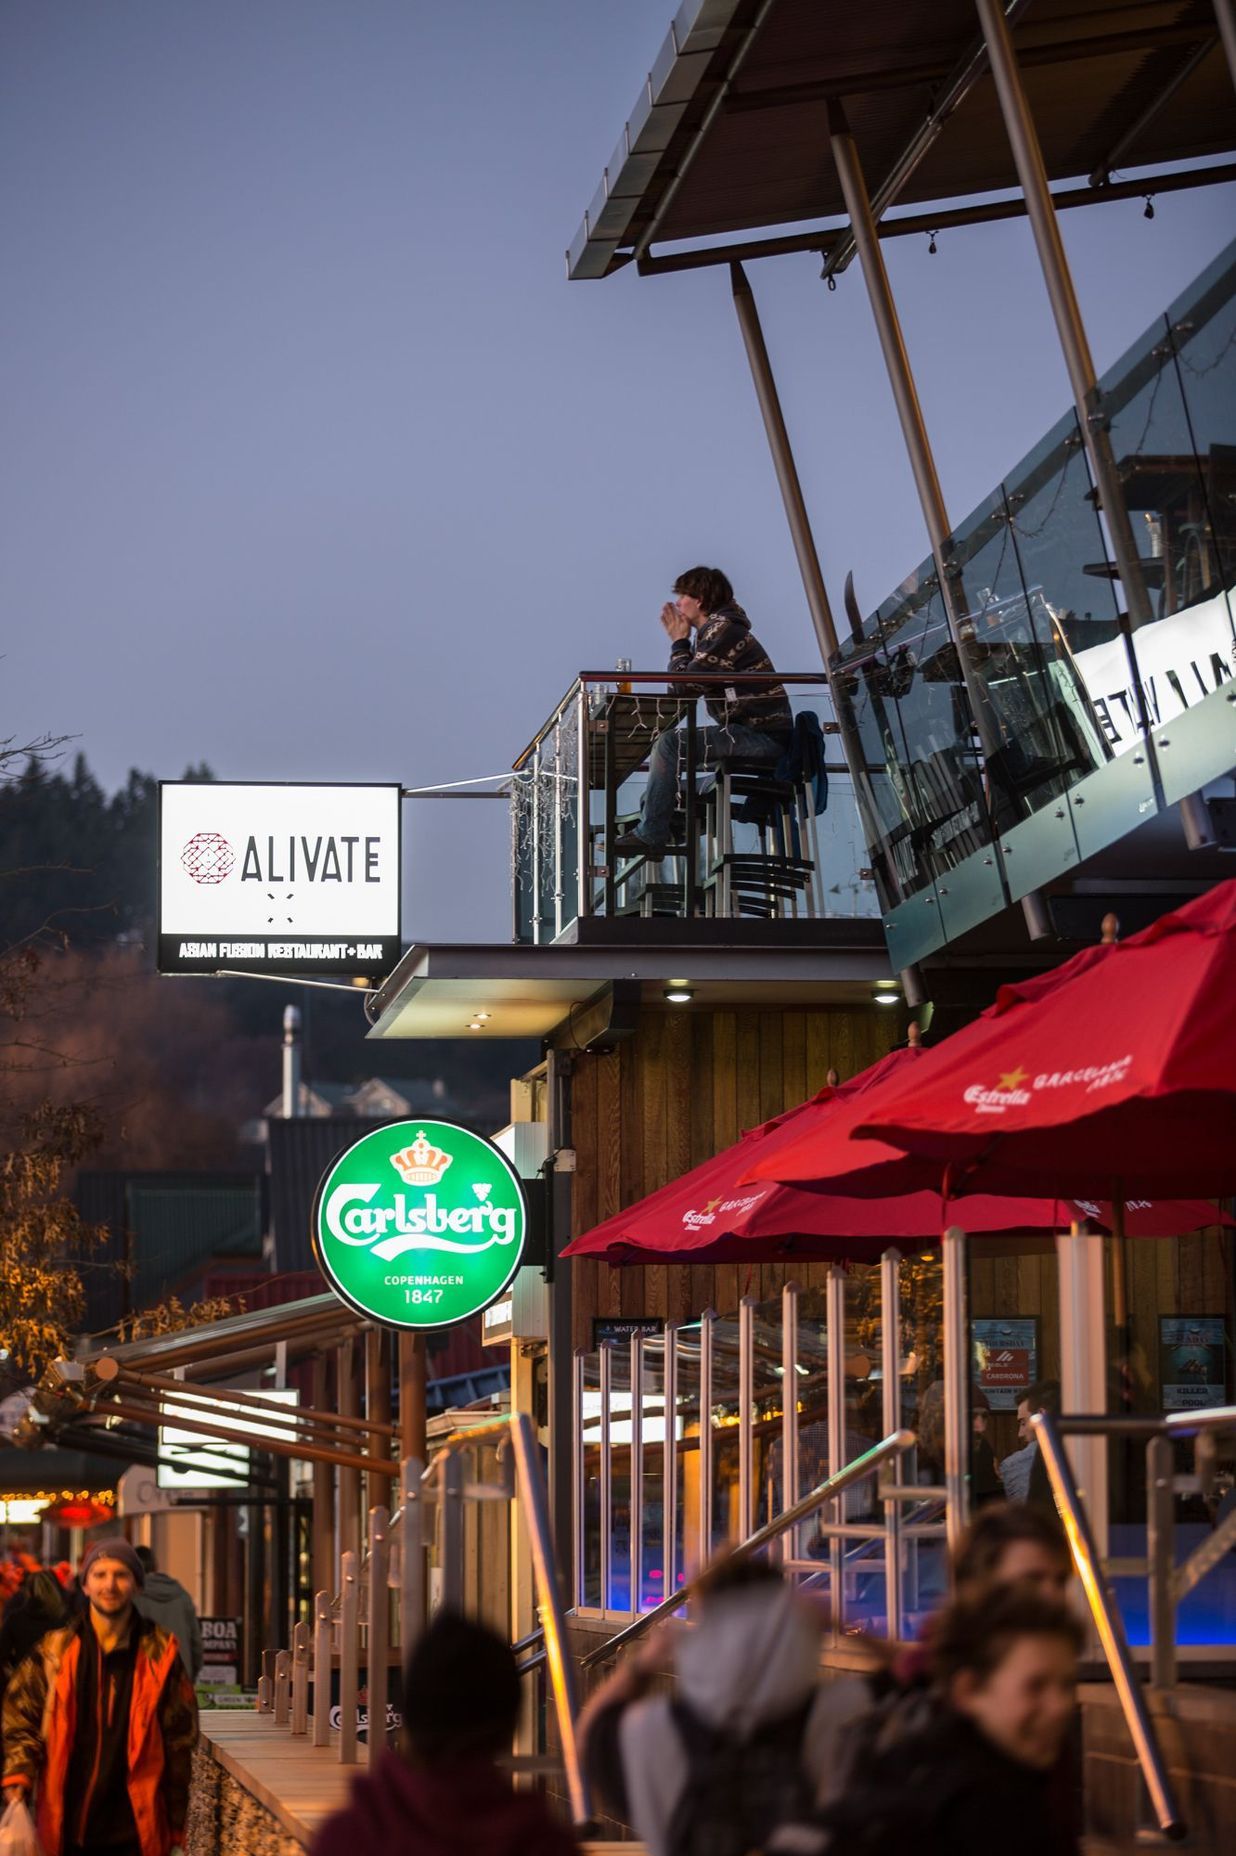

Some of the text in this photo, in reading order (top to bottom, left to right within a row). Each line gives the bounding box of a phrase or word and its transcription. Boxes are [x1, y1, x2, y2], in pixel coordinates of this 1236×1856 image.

[241, 836, 381, 882] ALIVATE
[179, 943, 217, 958] ASIAN
[219, 943, 265, 958] FUSION
[326, 1183, 516, 1247] Carlsberg
[384, 1276, 464, 1285] COPENHAGEN
[404, 1290, 444, 1304] 1847
[329, 1705, 402, 1731] Clsrg
